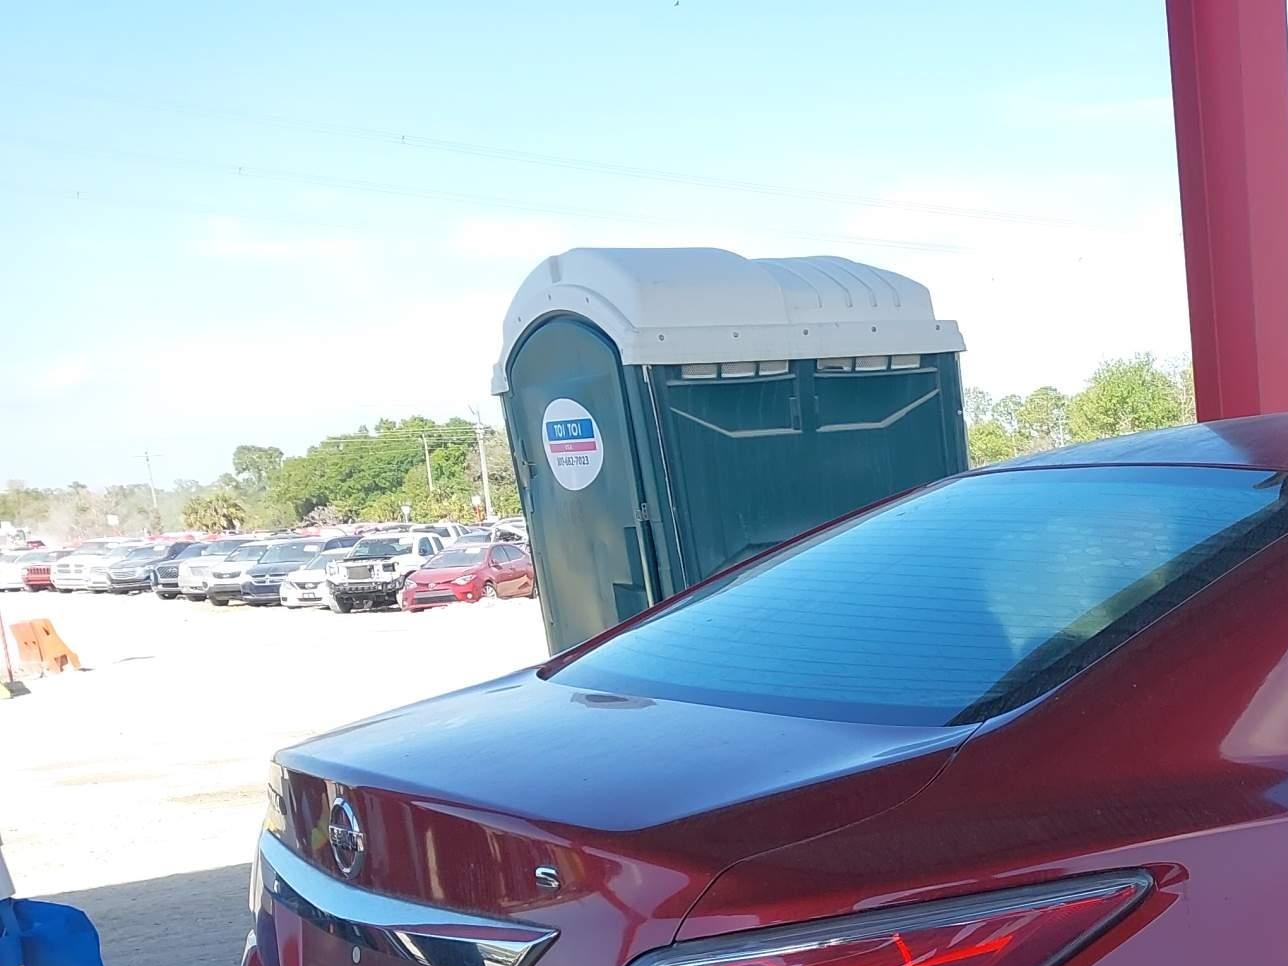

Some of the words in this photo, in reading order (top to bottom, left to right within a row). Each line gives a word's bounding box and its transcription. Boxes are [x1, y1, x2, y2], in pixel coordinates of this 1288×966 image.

[553, 424, 566, 438] TOI
[567, 423, 582, 437] TOI
[535, 866, 560, 888] S
